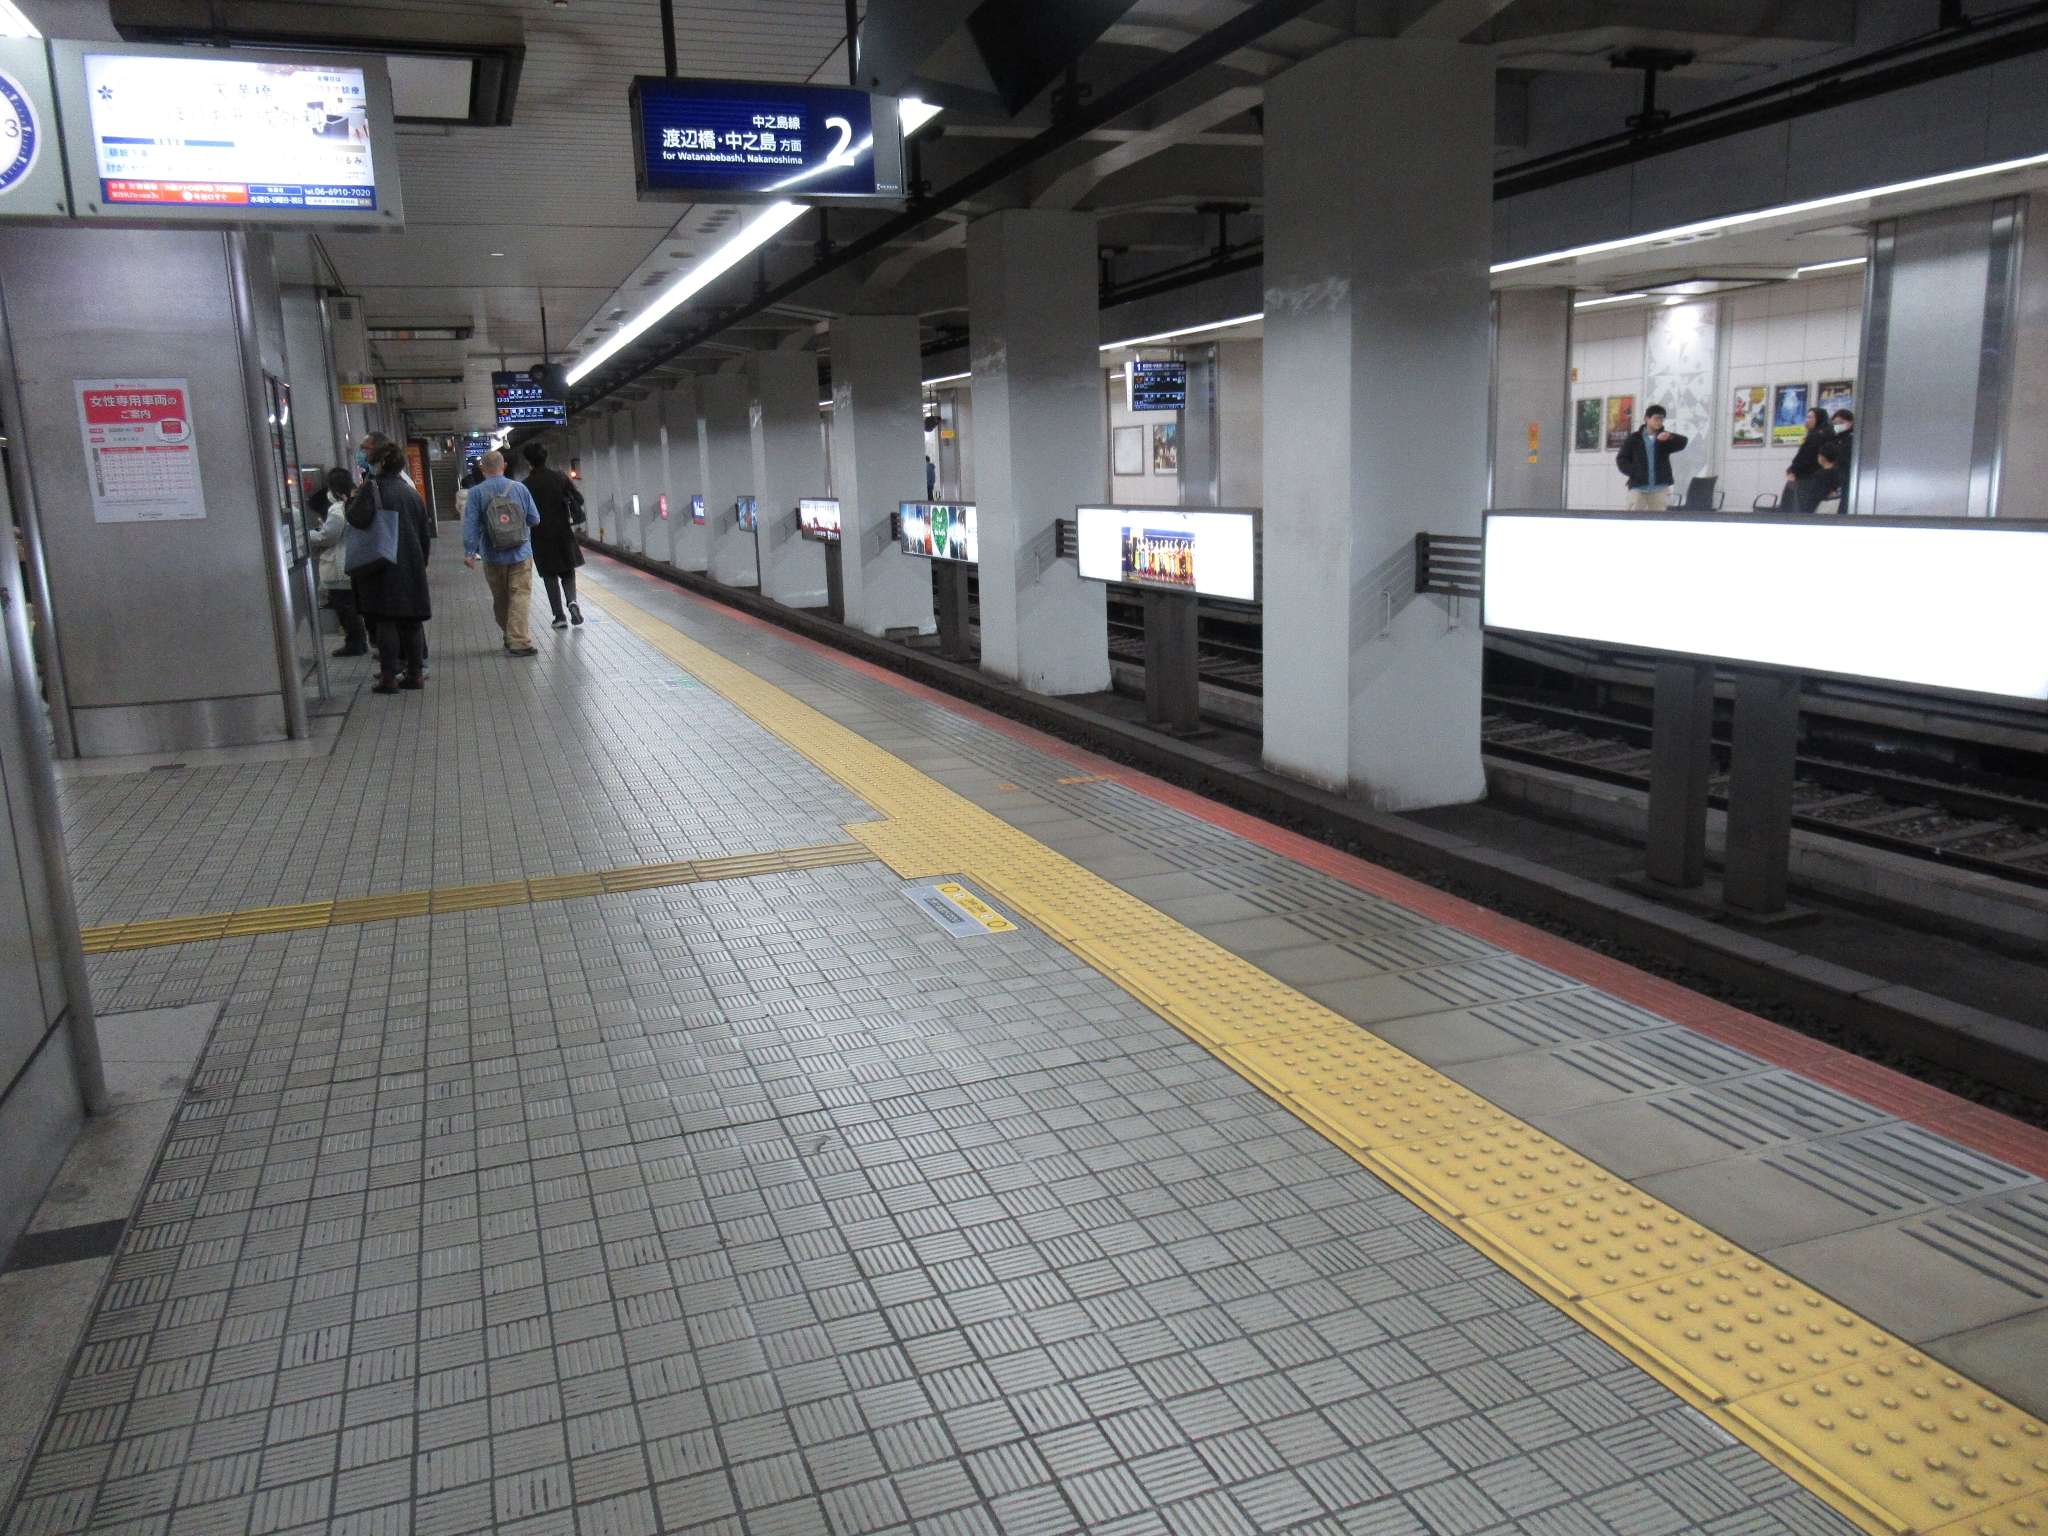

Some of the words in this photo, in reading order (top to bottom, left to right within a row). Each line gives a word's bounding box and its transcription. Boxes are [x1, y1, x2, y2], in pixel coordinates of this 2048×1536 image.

[4, 118, 20, 138] 3
[753, 115, 800, 129] 中之島線
[663, 129, 777, 151] 渡辺橋・中之島
[780, 139, 801, 152] 方面
[826, 117, 854, 166] 2
[663, 151, 675, 160] for
[678, 151, 745, 163] Watanabebashi,
[747, 155, 803, 164] Nakanoshima
[90, 394, 177, 408] 女性専用車両の
